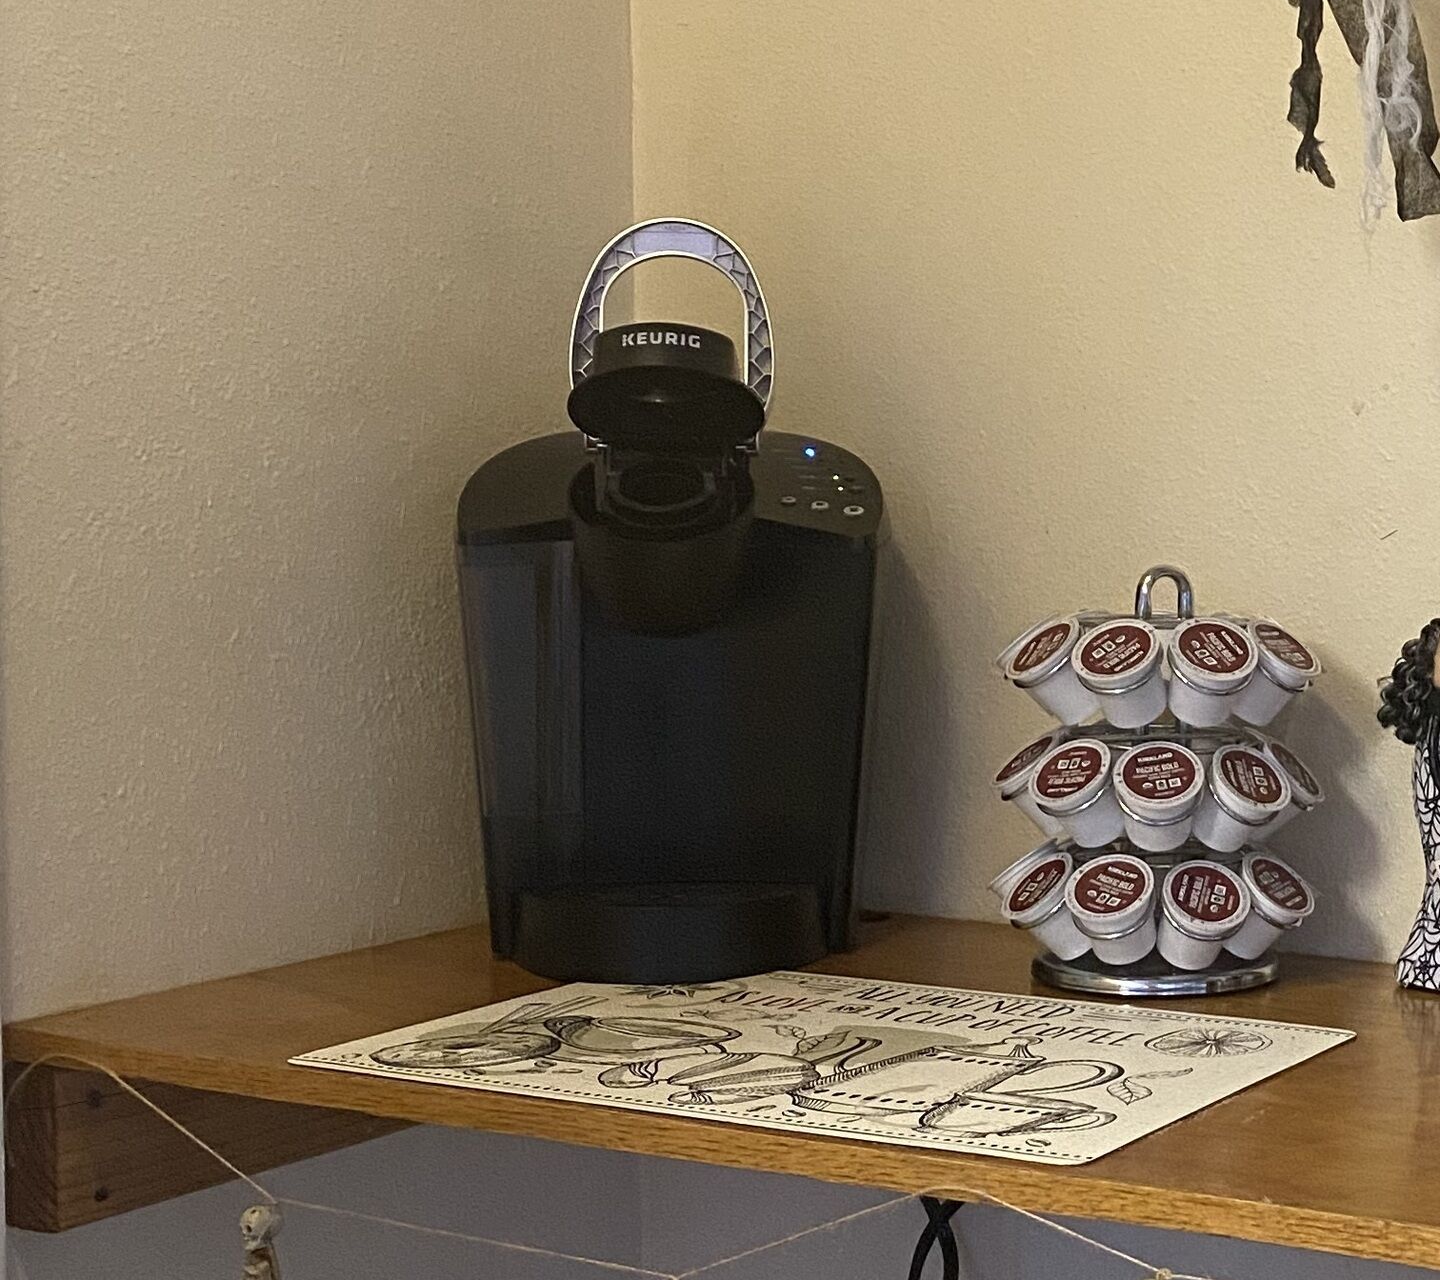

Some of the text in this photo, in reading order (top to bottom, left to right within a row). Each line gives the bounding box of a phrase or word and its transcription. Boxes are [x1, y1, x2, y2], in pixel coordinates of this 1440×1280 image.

[622, 331, 700, 349] KEURIG
[844, 985, 1075, 1019] ALL YOU NEED
[741, 993, 837, 1012] LOVE
[861, 1006, 901, 1020] A
[893, 1010, 977, 1026] CUP
[968, 1019, 1028, 1031] OF
[1012, 1022, 1145, 1047] COFFEE
